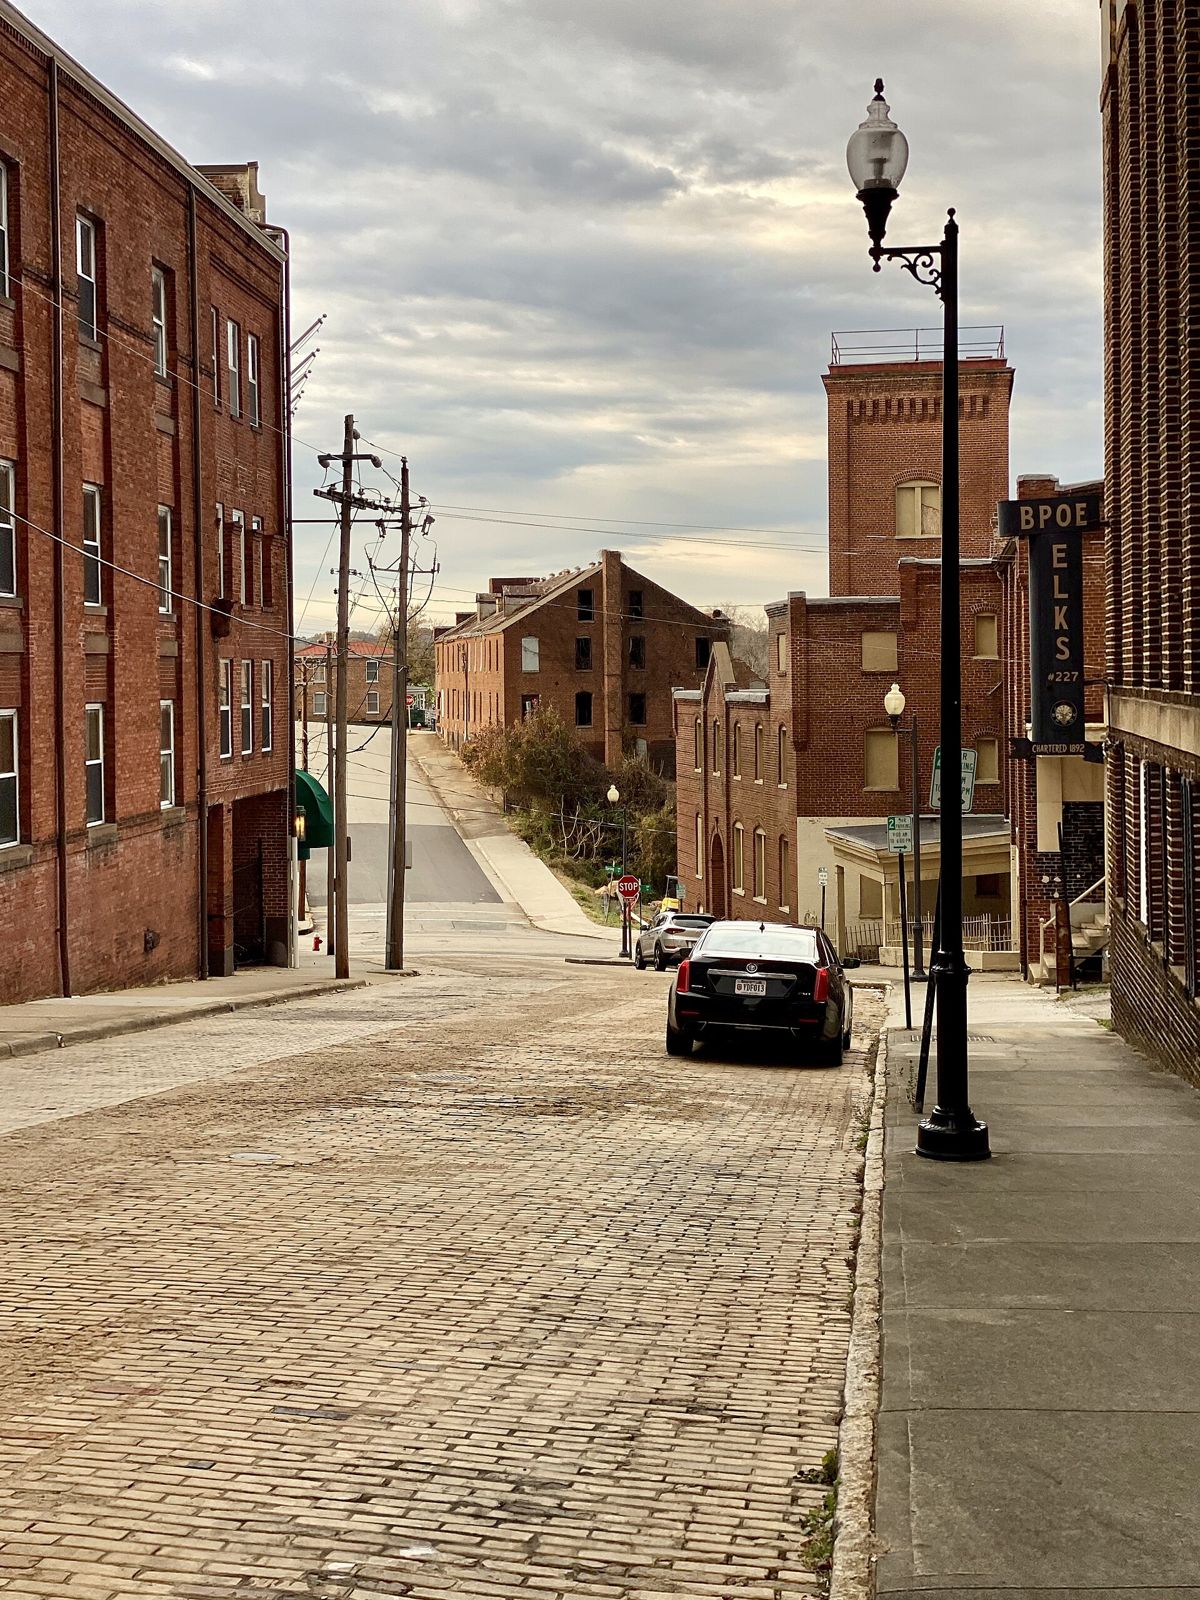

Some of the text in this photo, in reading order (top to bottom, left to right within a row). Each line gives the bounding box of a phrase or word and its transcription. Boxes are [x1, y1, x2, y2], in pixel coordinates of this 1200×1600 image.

[1020, 503, 1087, 530] BPOE
[1052, 544, 1070, 661] ELKS
[1047, 672, 1079, 682] #227
[1032, 743, 1085, 754] CHARTERED 1892
[889, 820, 895, 829] 2
[619, 882, 638, 891] STOP
